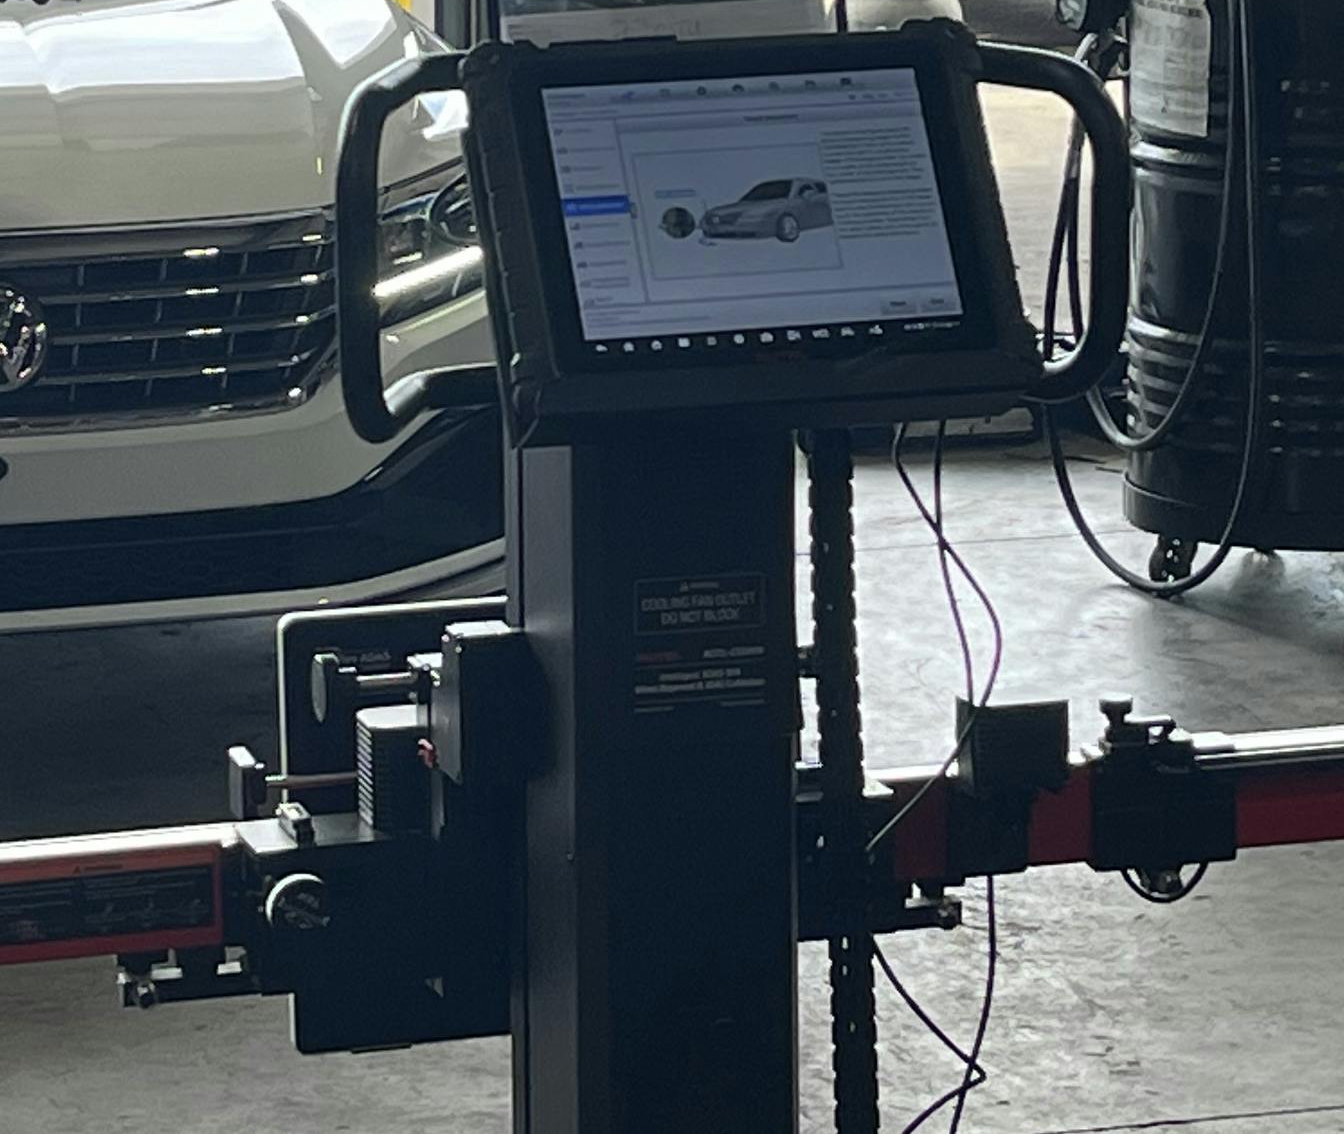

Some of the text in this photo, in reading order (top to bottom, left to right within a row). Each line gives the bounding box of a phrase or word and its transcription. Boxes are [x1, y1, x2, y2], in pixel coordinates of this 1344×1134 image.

[641, 596, 690, 611] COOLING
[692, 594, 713, 607] FAN
[661, 612, 677, 625] DO
